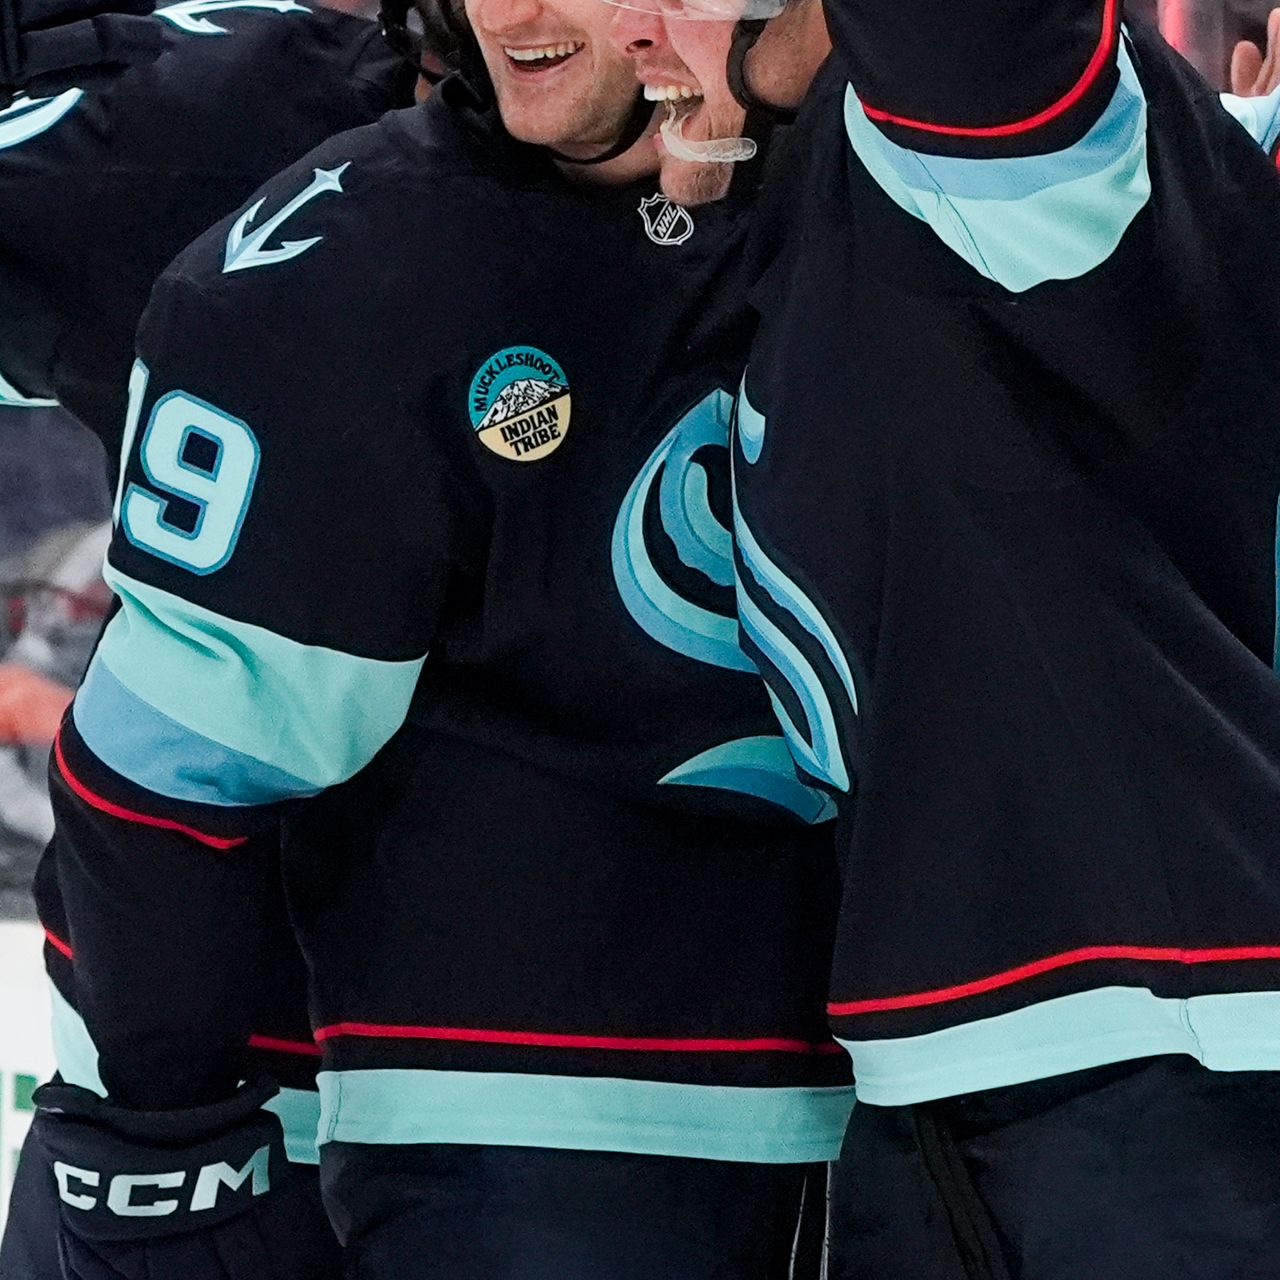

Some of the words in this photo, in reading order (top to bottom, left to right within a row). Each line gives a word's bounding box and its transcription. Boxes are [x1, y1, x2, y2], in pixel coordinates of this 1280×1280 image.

[656, 205, 677, 238] NHL
[474, 352, 560, 412] MUCKLESHOOT
[500, 404, 559, 443] INDIAN
[509, 423, 562, 456] TRIBE
[54, 1144, 270, 1217] CCM
